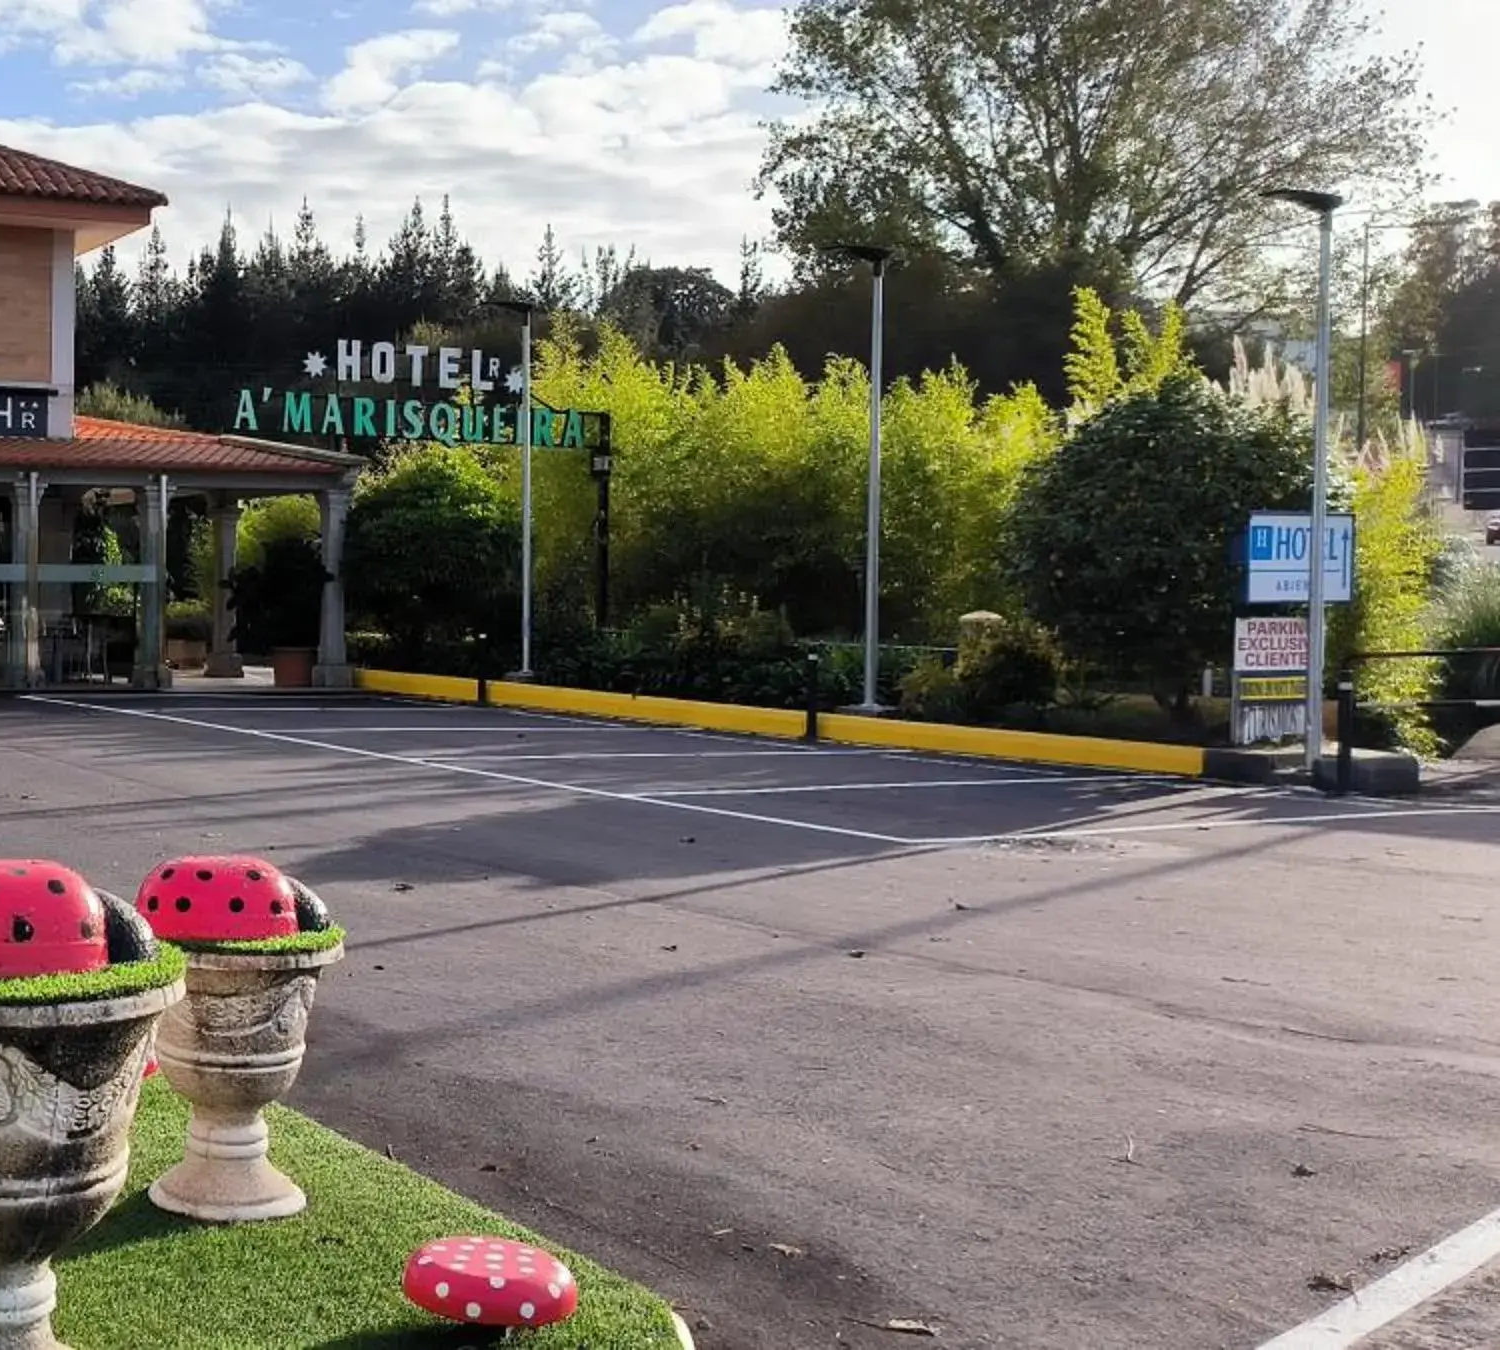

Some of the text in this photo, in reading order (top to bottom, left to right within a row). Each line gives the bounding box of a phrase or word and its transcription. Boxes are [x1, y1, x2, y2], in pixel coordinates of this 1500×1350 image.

[337, 338, 494, 391] HOTEL
[1277, 526, 1338, 561] HOL
[1247, 621, 1304, 635] PARKIN
[1245, 652, 1309, 667] CLIENTE
